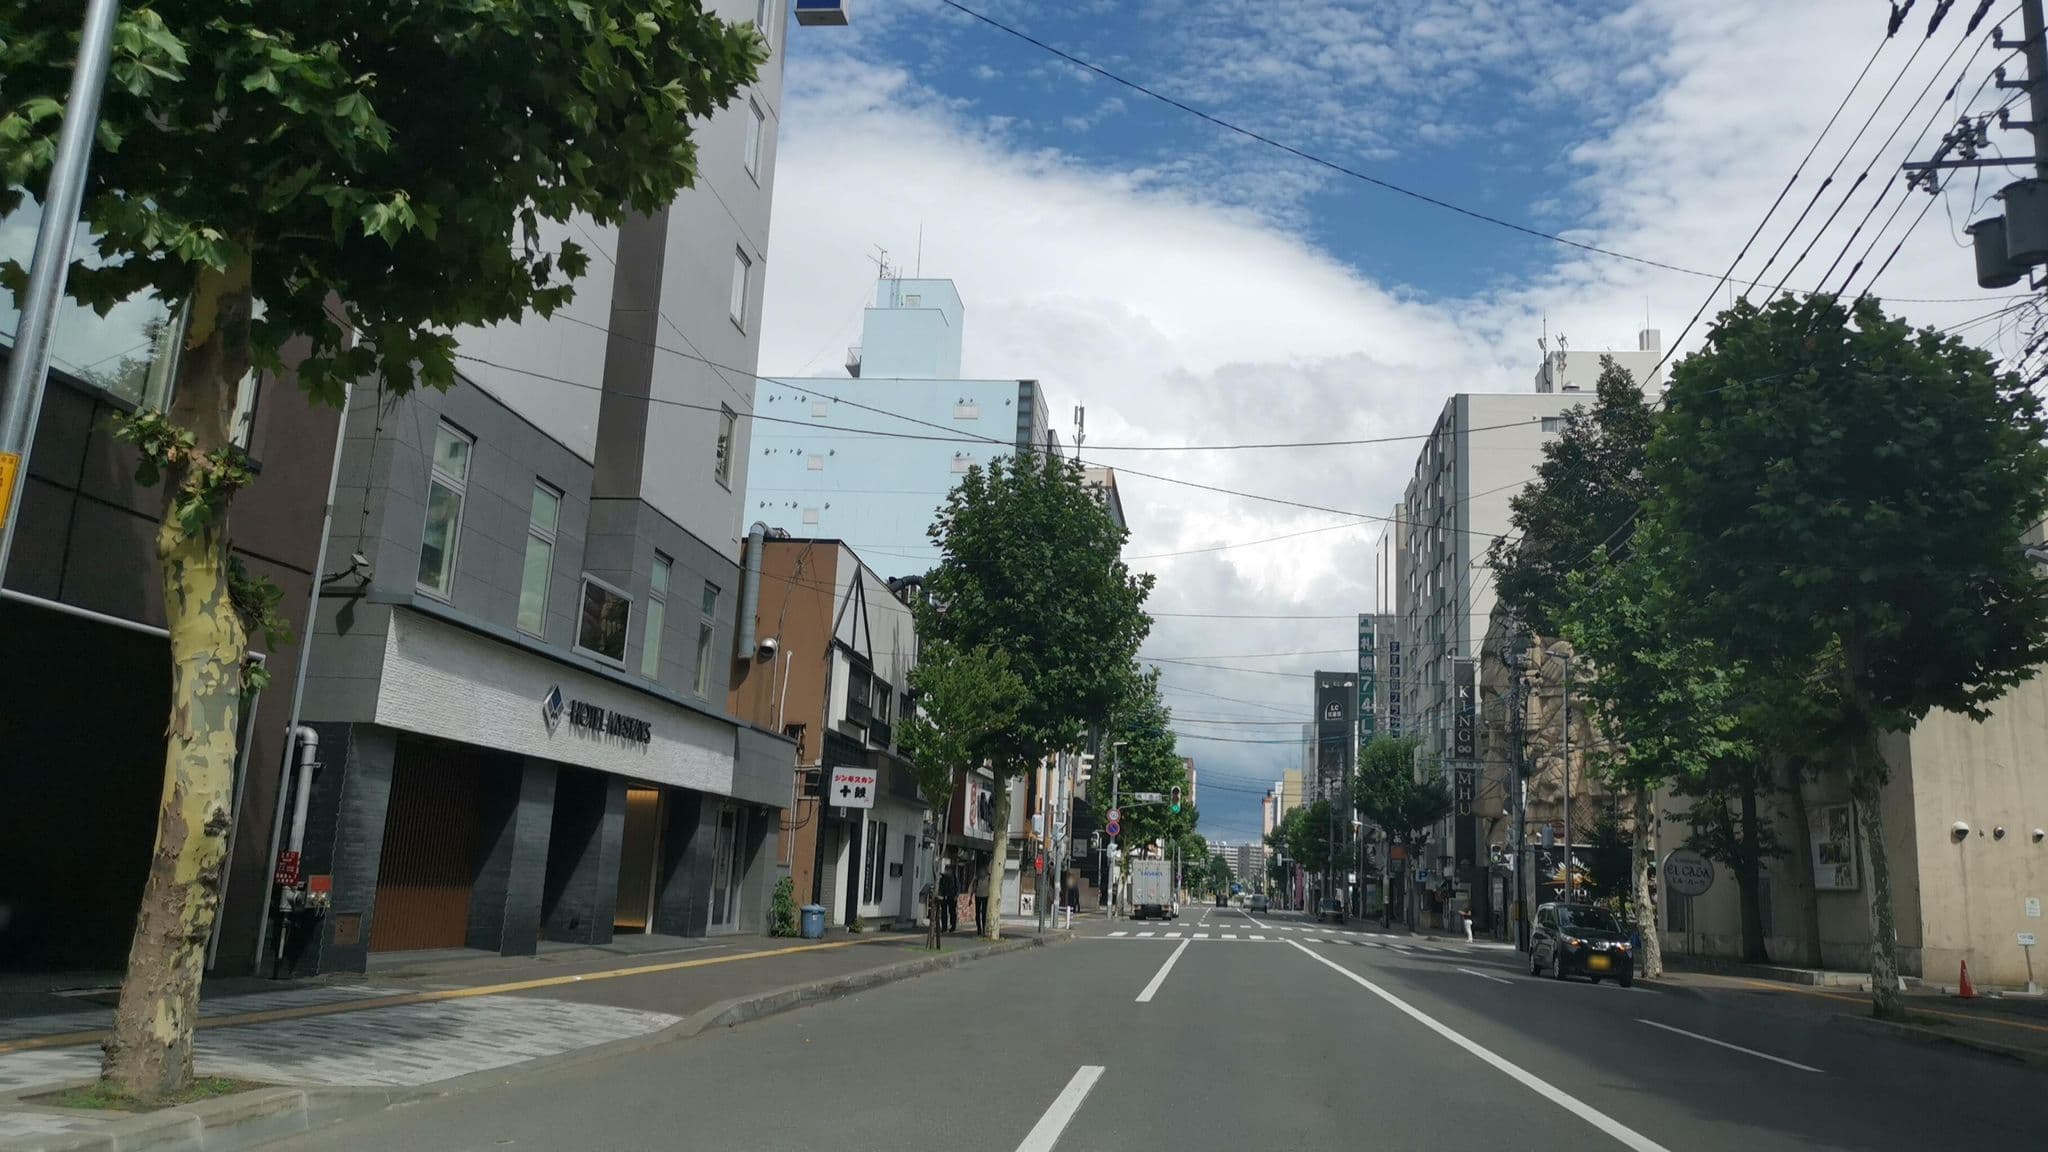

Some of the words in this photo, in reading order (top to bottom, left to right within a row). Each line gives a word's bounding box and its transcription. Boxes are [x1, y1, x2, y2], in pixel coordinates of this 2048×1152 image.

[569, 699, 605, 732] HOTEL
[834, 774, 875, 784] ジンギスカン
